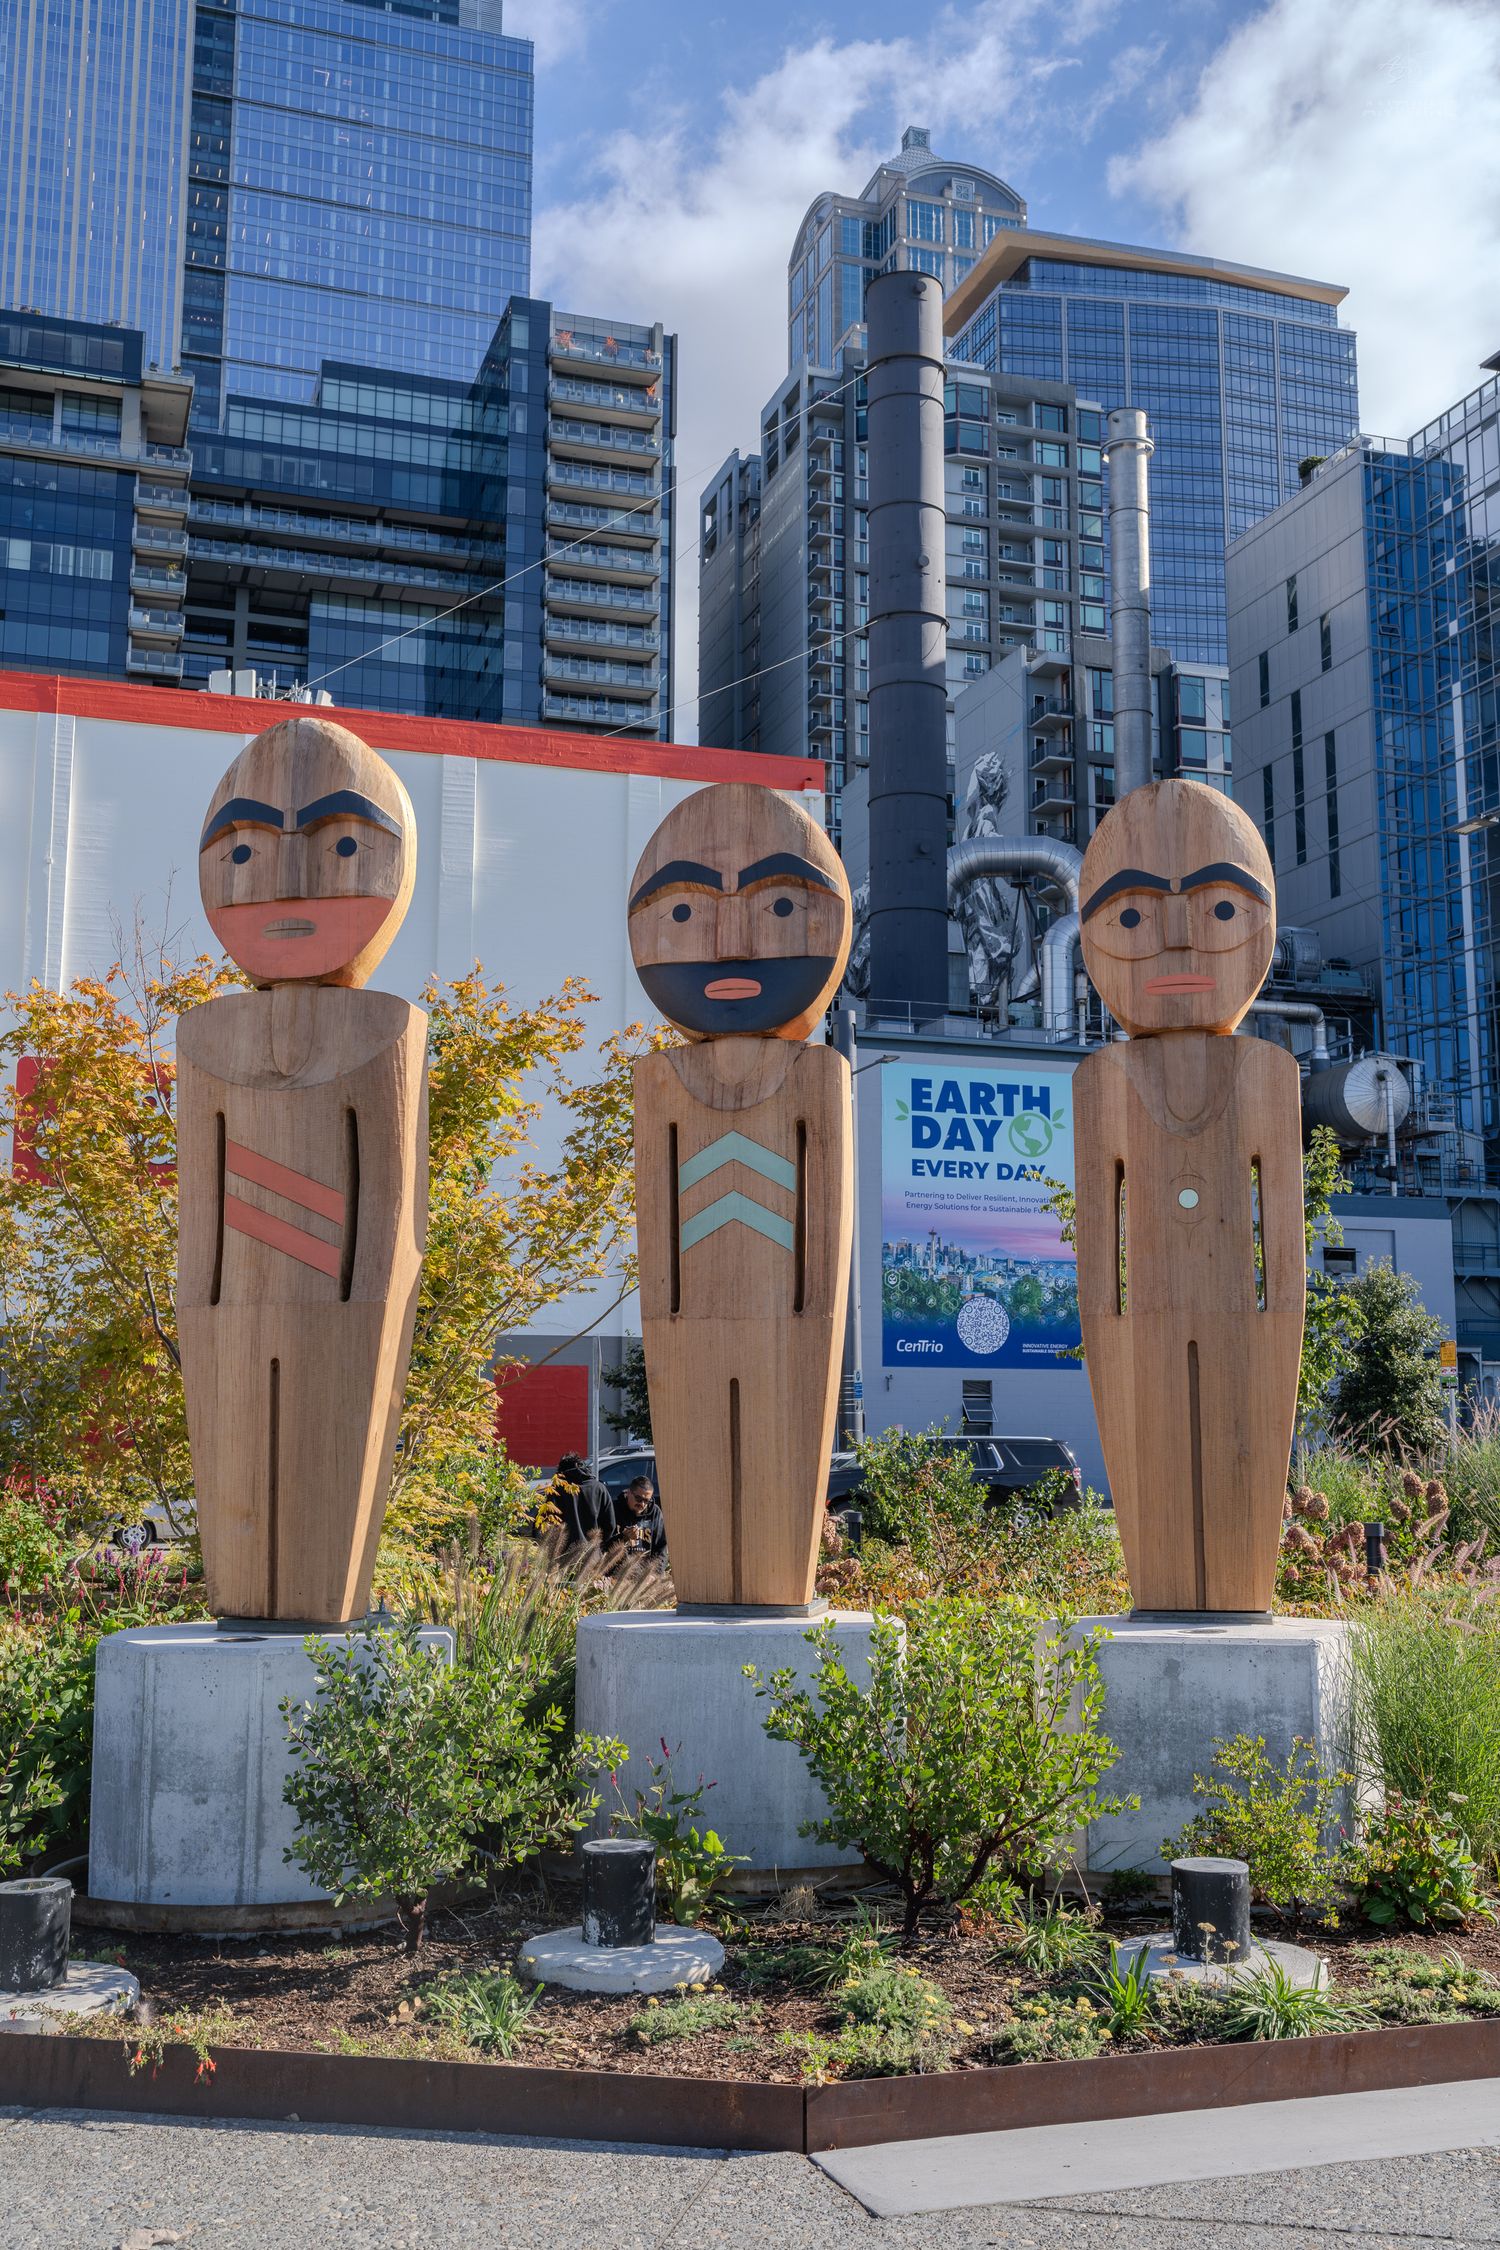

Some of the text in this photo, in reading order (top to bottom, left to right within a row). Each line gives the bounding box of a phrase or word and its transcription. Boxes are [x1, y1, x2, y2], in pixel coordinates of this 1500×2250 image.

[911, 1078, 1050, 1120] EARTH
[911, 1115, 1003, 1152] DAY
[911, 1158, 990, 1179] EVERY
[904, 1190, 945, 1200] Partnering
[956, 1193, 982, 1201] Deliver
[983, 1194, 1018, 1203] Resilient,
[1019, 1196, 1053, 1204] Innovati
[906, 1201, 933, 1211] Energy
[934, 1202, 969, 1211] Solutions
[970, 1203, 981, 1211] for
[988, 1205, 1032, 1213] Sustainable
[896, 1339, 944, 1353] CenTrio
